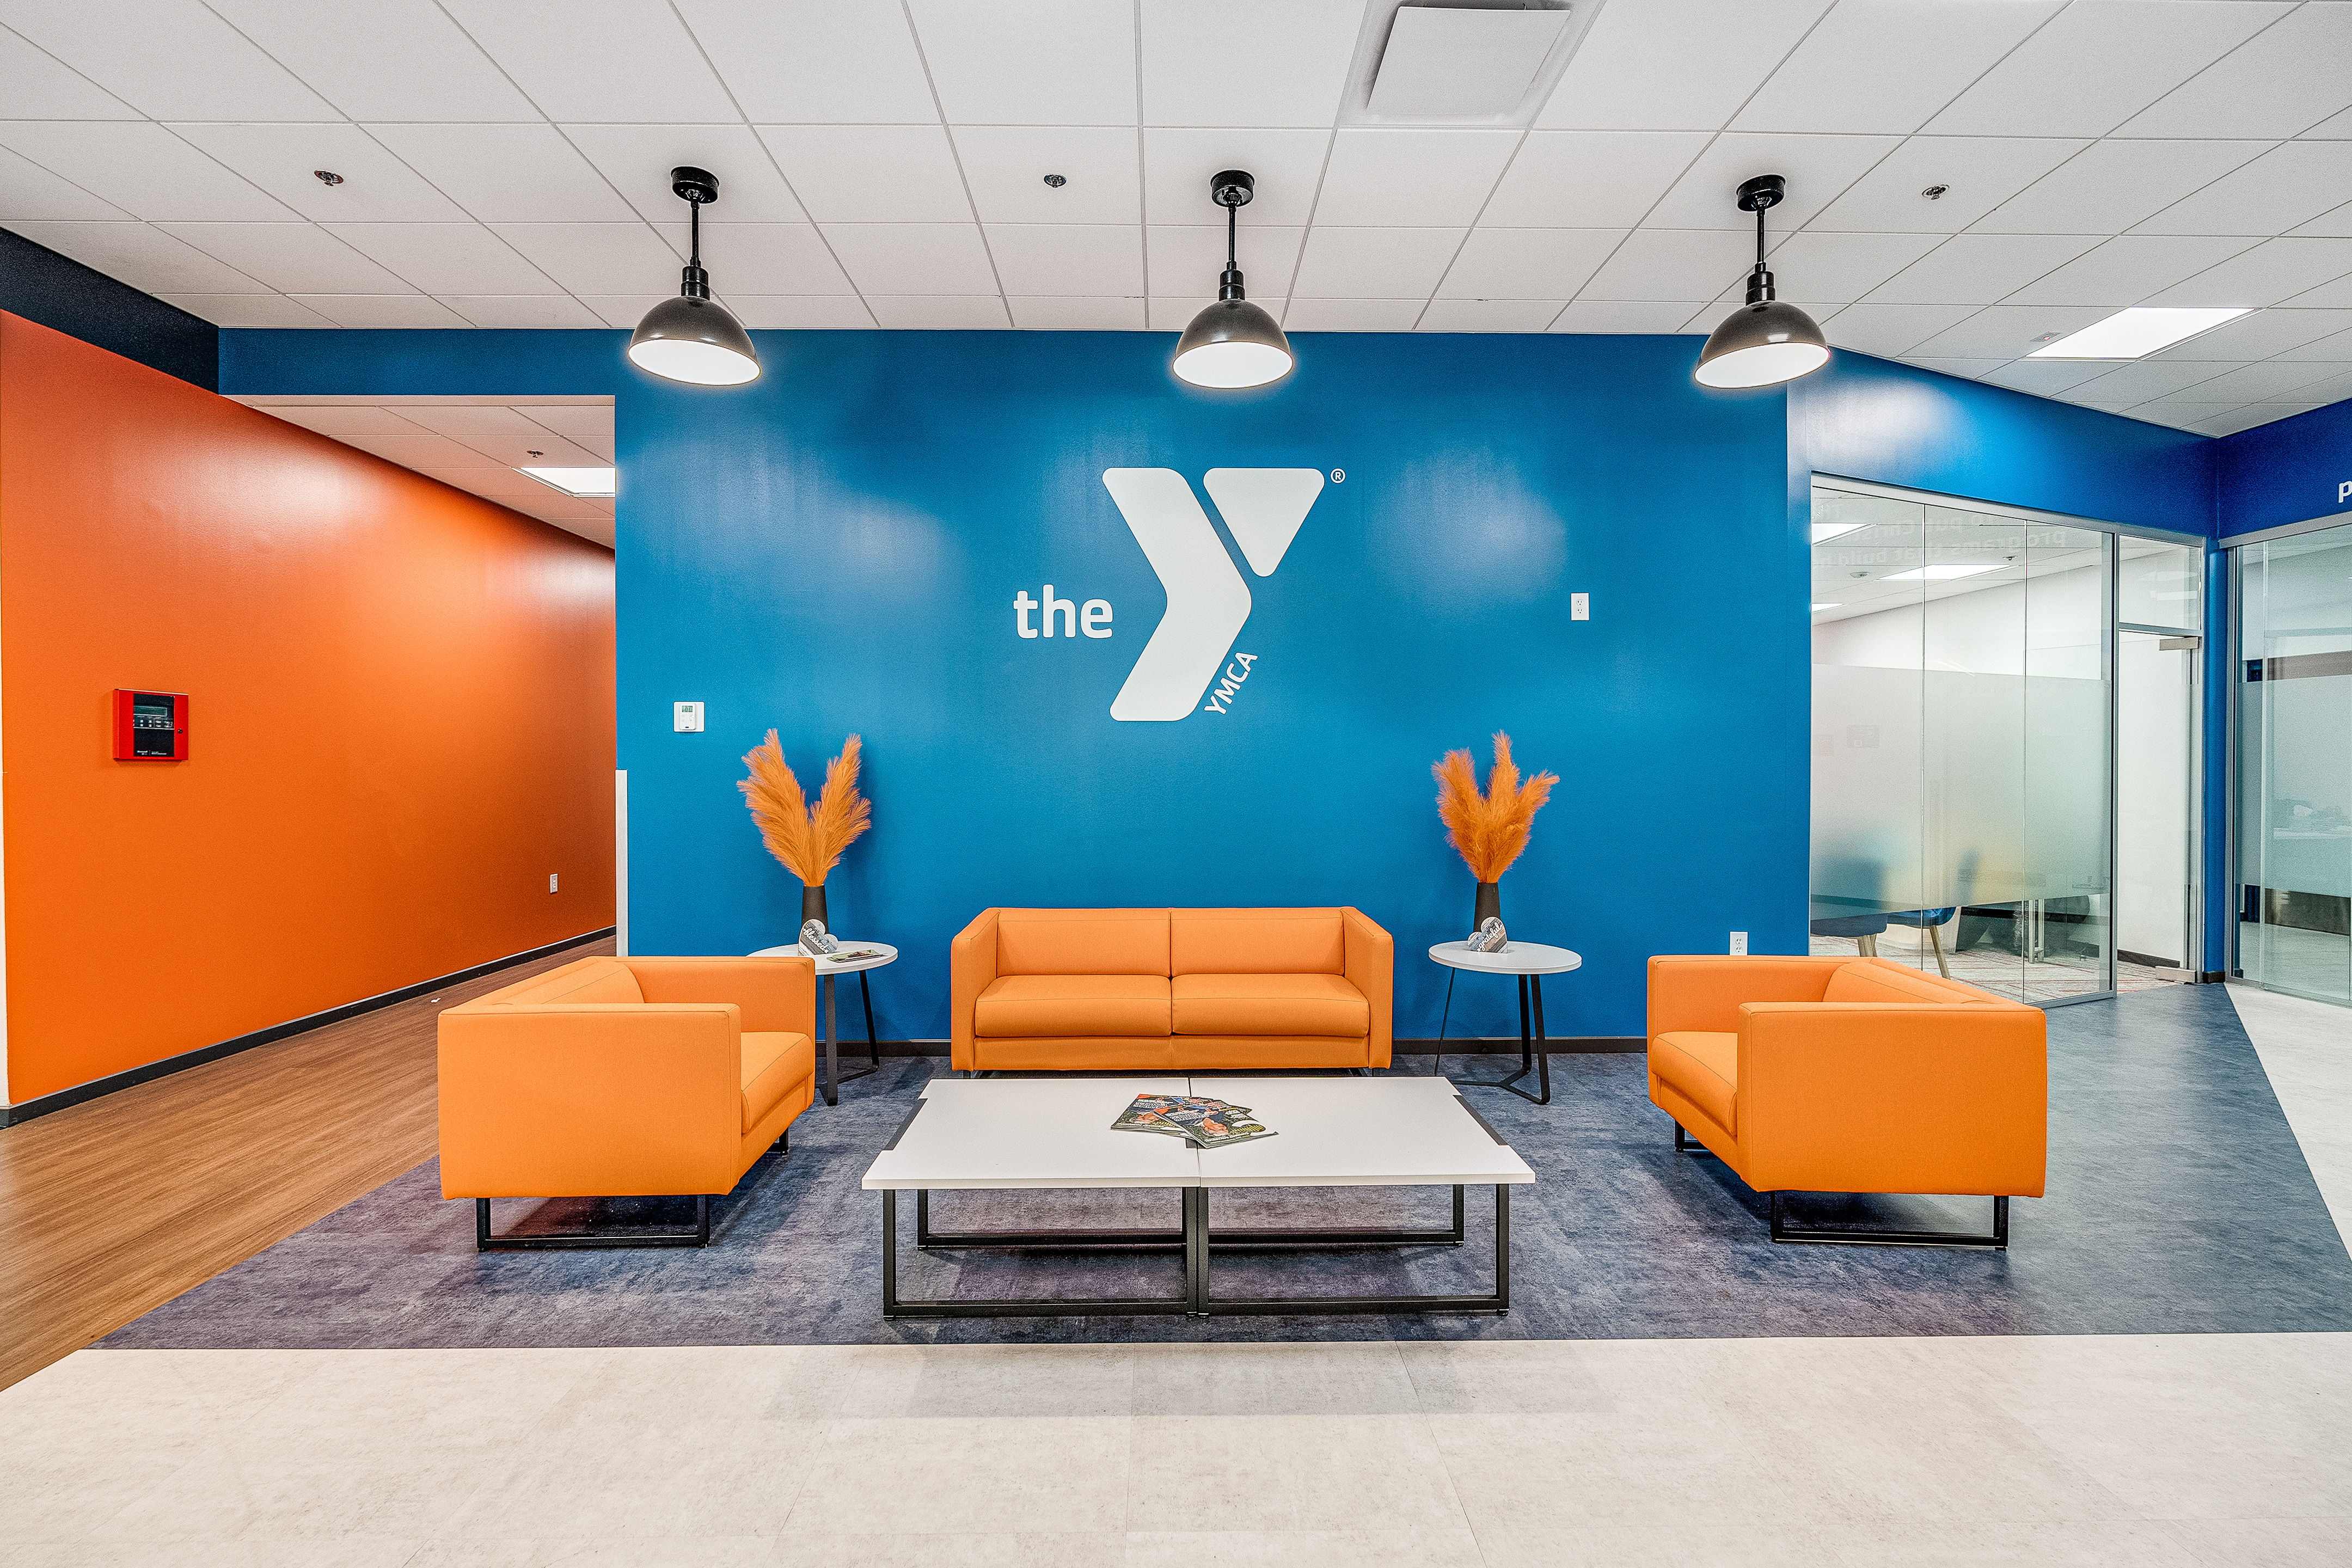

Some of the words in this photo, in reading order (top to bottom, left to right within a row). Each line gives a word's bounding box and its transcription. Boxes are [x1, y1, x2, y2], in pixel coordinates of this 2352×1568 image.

[1013, 584, 1114, 639] the
[1203, 651, 1258, 715] YMCA
[804, 928, 829, 952] blessed
[1478, 922, 1502, 952] grateful
